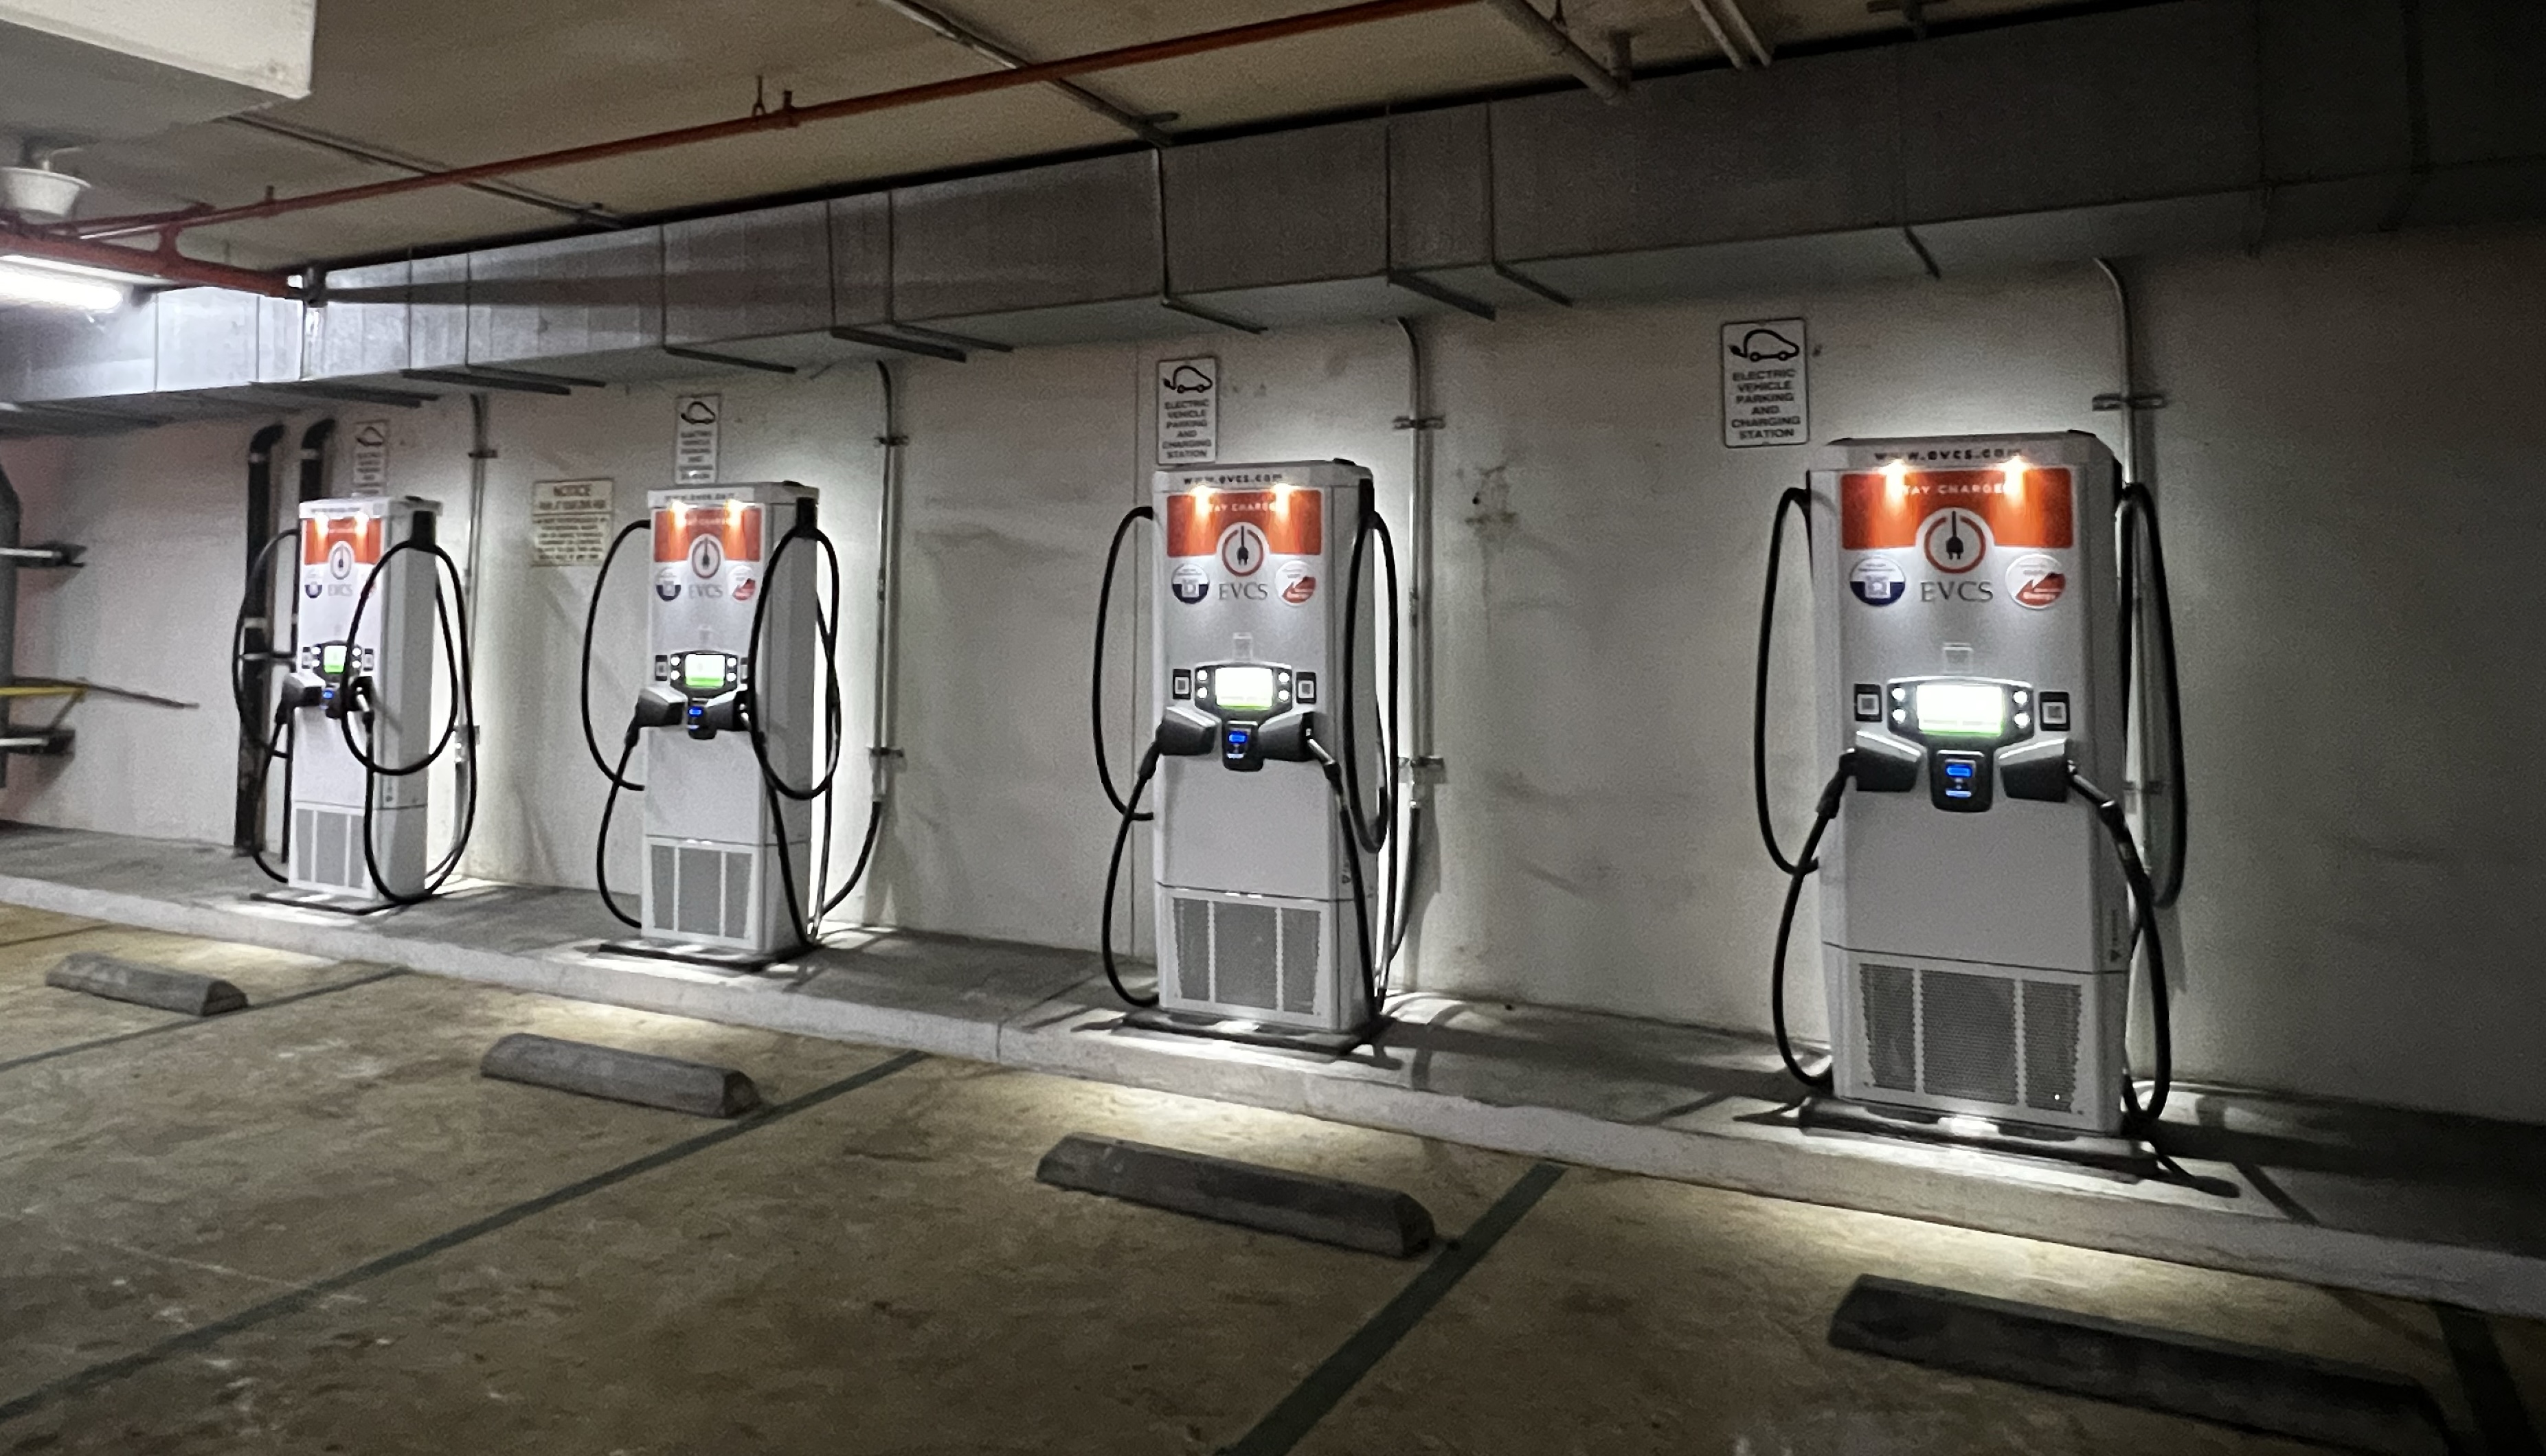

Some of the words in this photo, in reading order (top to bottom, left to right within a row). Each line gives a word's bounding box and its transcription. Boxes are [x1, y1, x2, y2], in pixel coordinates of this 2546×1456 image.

[1733, 368, 1796, 381] ELECTRIC
[1737, 380, 1792, 392] VEHICLE
[1164, 398, 1209, 409] ELECTRIC
[1736, 392, 1794, 404] PARKING
[1167, 409, 1206, 418] VEHICLE
[1752, 405, 1780, 415] AND
[1166, 419, 1208, 429] PARKING
[1731, 416, 1801, 429] CHARGING
[1739, 429, 1794, 440] STATION
[1162, 439, 1212, 449] CHARGING
[1167, 450, 1208, 459] STATION
[1938, 483, 2012, 495] CHARGE
[1218, 582, 1268, 600] EVCS
[1921, 581, 1994, 602] EVCS
